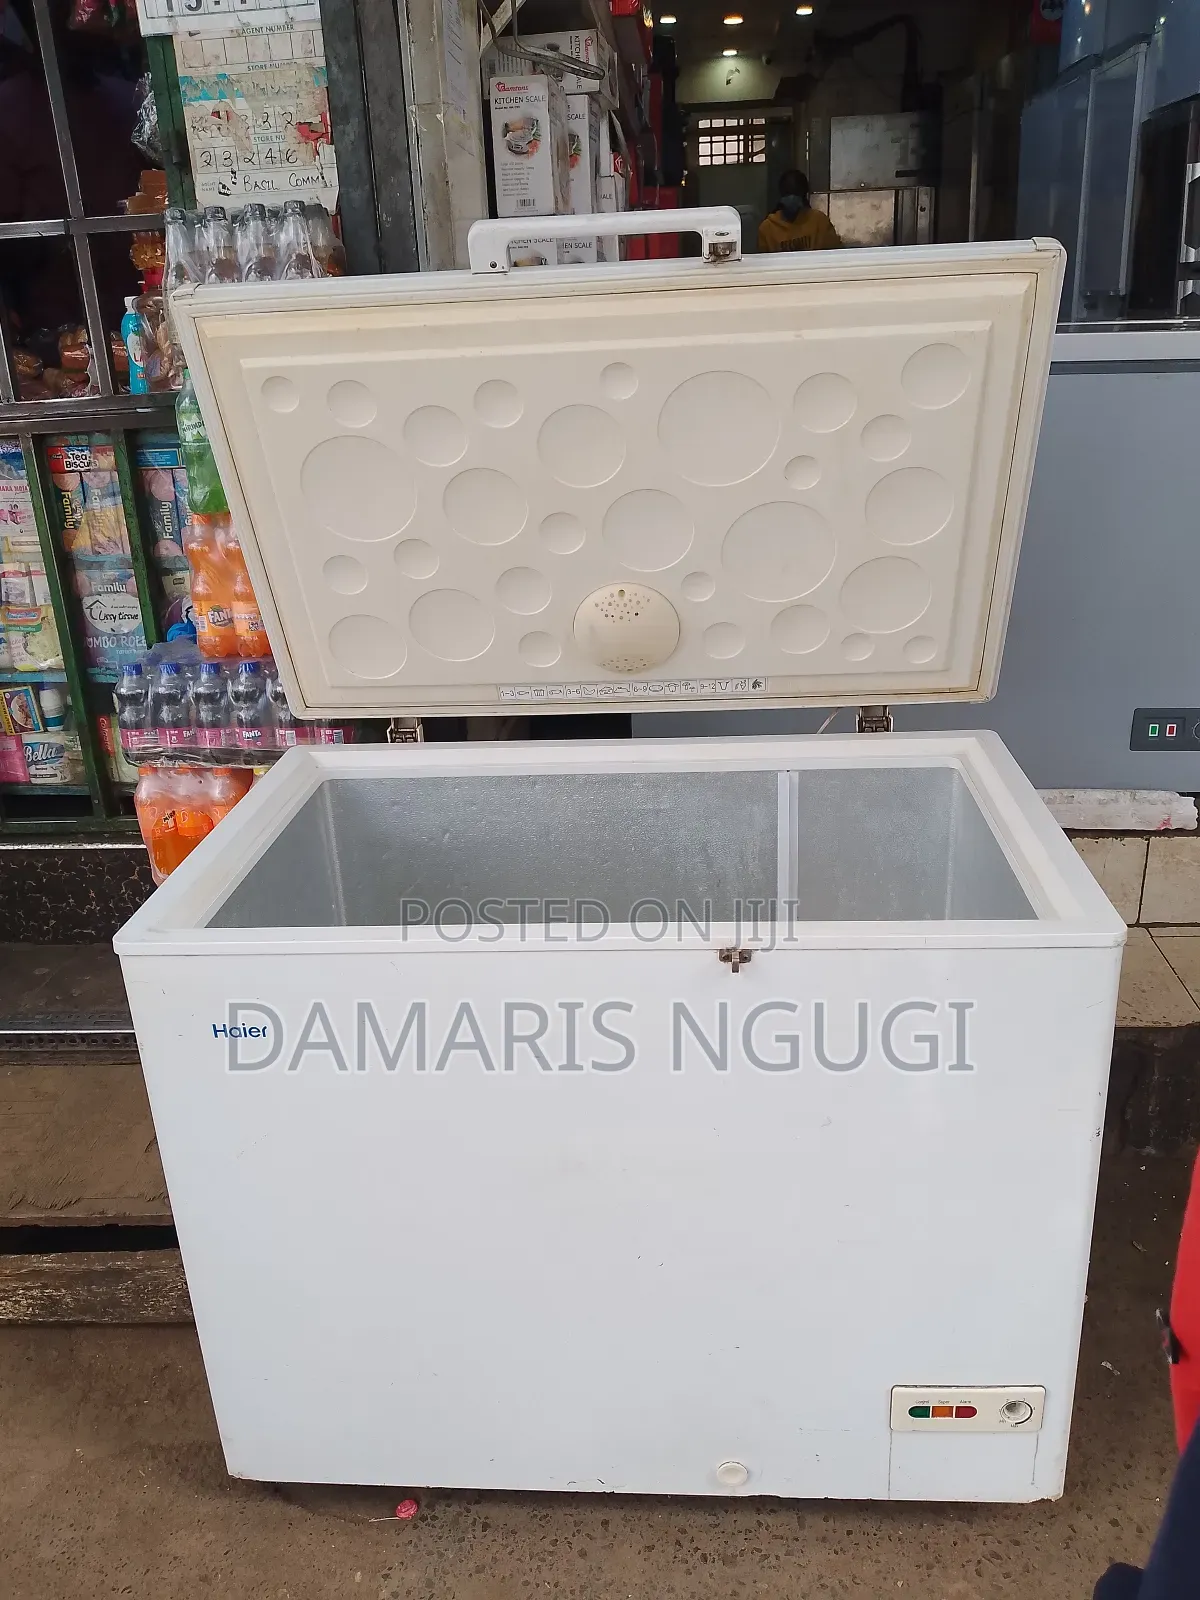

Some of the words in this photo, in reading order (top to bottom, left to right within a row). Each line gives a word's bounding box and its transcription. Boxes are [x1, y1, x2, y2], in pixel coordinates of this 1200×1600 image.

[241, 27, 264, 35] AGENT
[265, 24, 295, 33] NUMBER
[494, 96, 524, 105] KITCHEN
[525, 94, 546, 103] SCALE
[567, 113, 586, 121] SCALE
[253, 134, 274, 142] STORE
[574, 241, 592, 249] SCALE
[69, 452, 88, 461] Tea
[61, 491, 76, 529] Family
[160, 500, 174, 540] Family
[90, 581, 126, 593] Family
[118, 611, 139, 620] tissue
[207, 608, 232, 623] FANT
[86, 636, 117, 649] UMBO
[242, 729, 262, 738] FANTA
[24, 744, 58, 762] Bella
[212, 1022, 267, 1038] Haier
